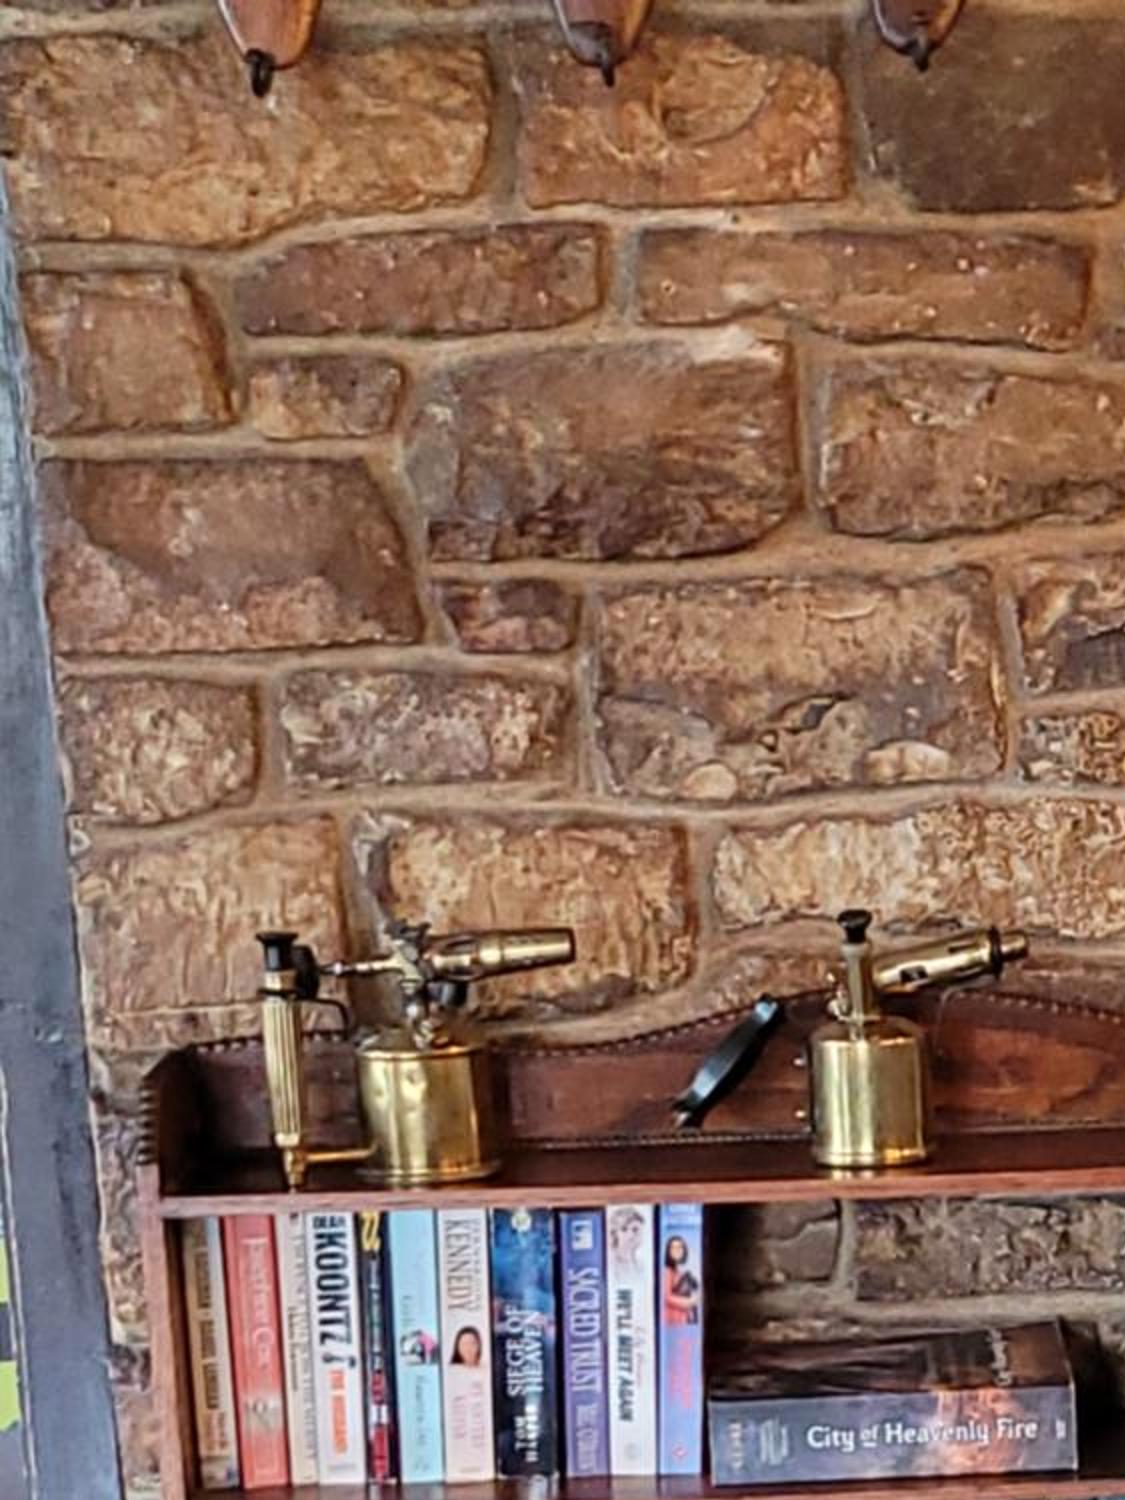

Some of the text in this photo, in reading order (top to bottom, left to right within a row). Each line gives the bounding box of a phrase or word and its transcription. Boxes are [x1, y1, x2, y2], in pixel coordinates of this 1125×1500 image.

[316, 1233, 351, 1345] KOONTZ
[443, 1219, 475, 1312] KENNEDY
[503, 1303, 526, 1397] SIEGE OF
[519, 1310, 545, 1395] HEAVEN
[569, 1266, 602, 1393] SACRED TRUST
[514, 1415, 528, 1451] TOM
[618, 1375, 634, 1422] AGAIN
[806, 1417, 1039, 1452] City of Heavenly Fire
